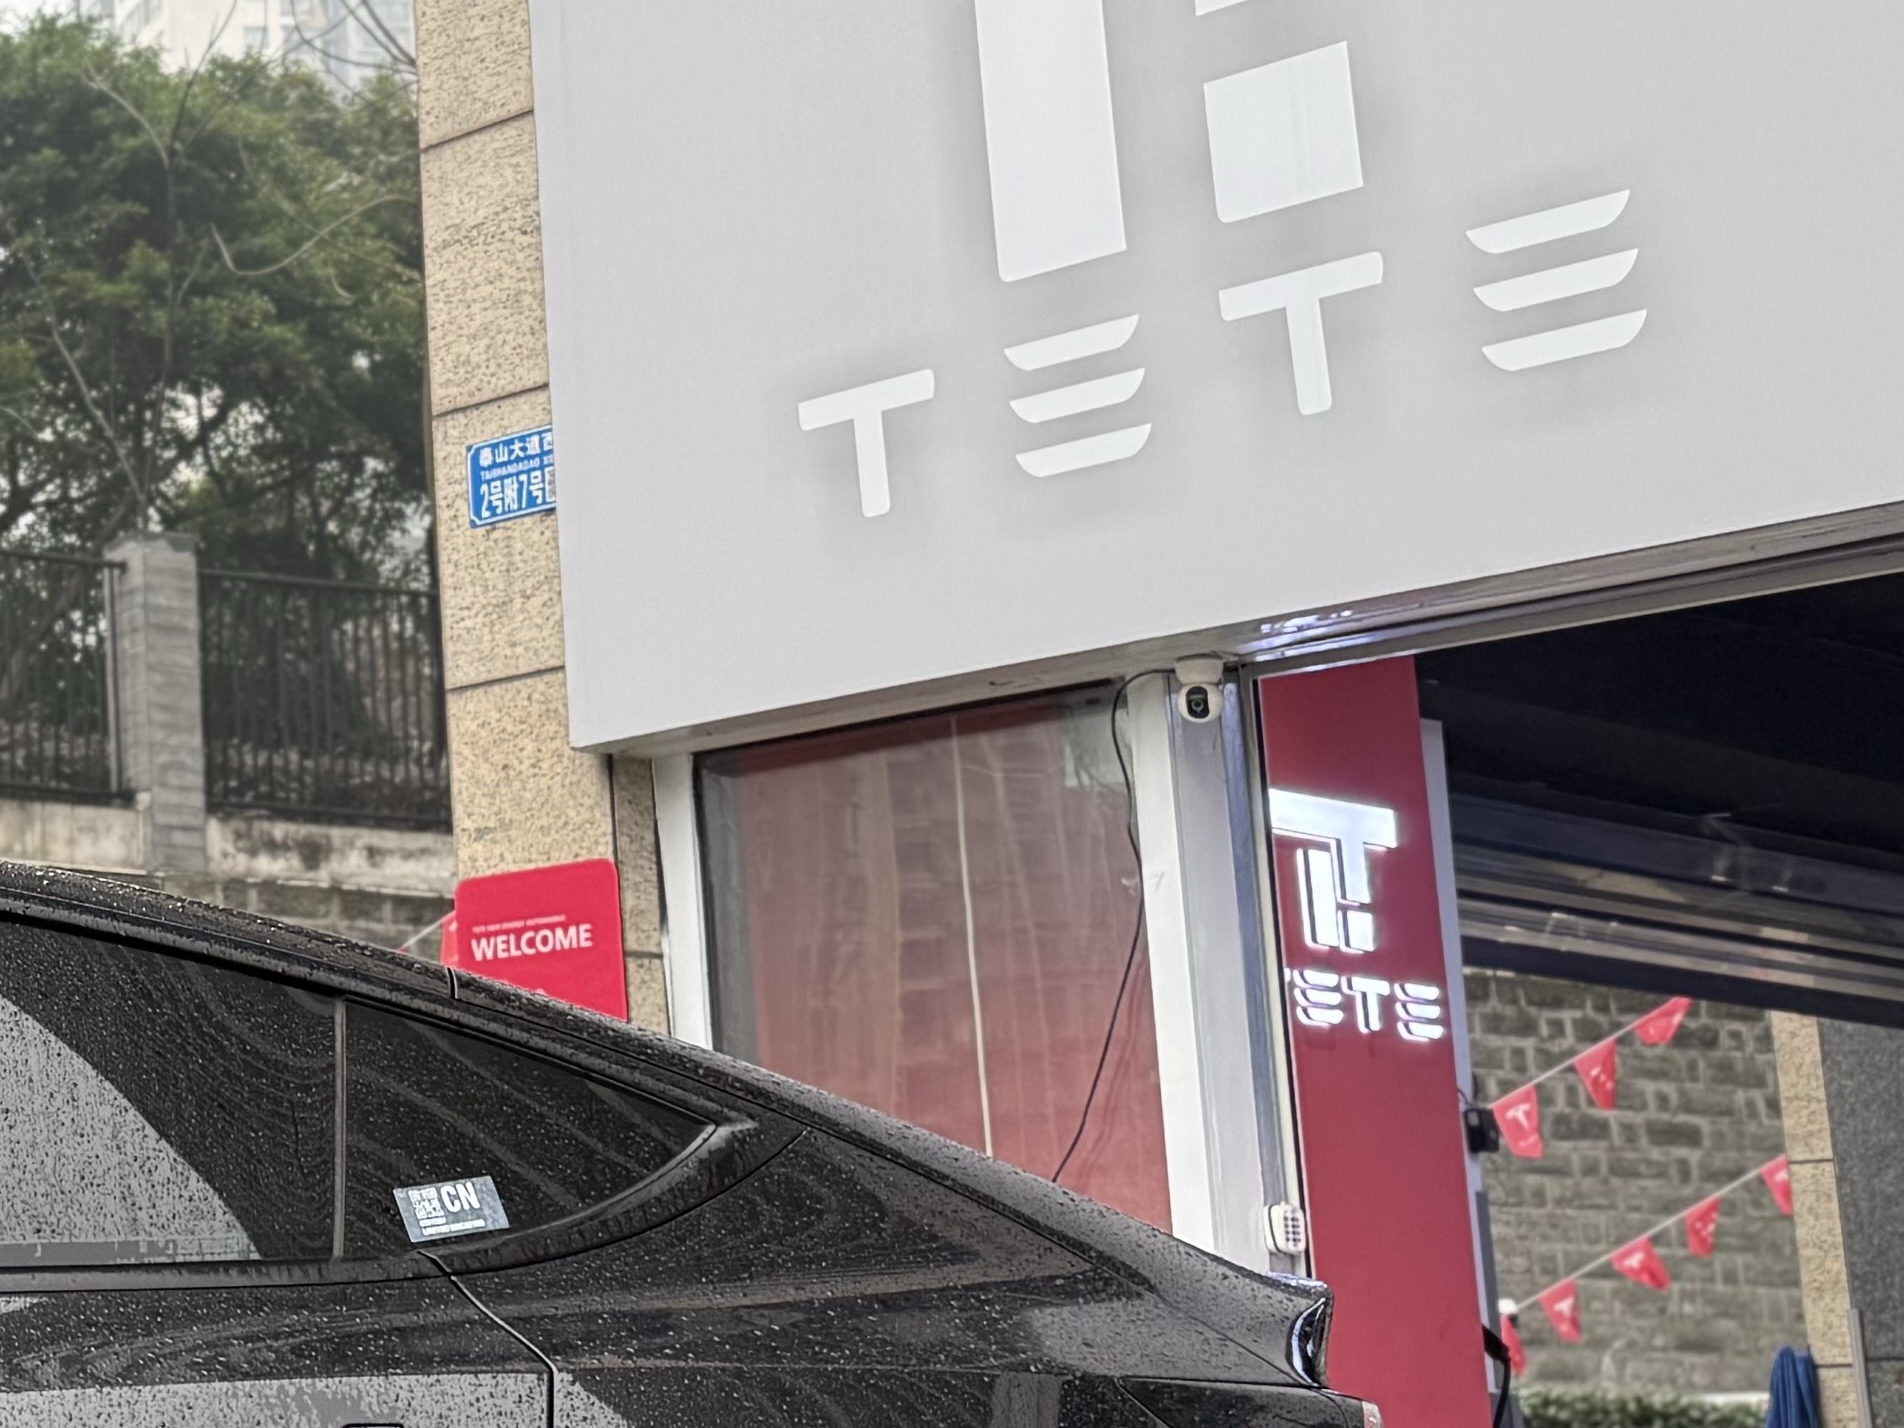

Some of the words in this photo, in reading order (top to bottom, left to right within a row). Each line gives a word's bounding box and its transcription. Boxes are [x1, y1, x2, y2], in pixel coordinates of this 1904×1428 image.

[798, 189, 1647, 517] TETE
[471, 924, 593, 962] WELCOME
[1284, 968, 1444, 1043] ETE
[440, 1181, 480, 1213] CN
